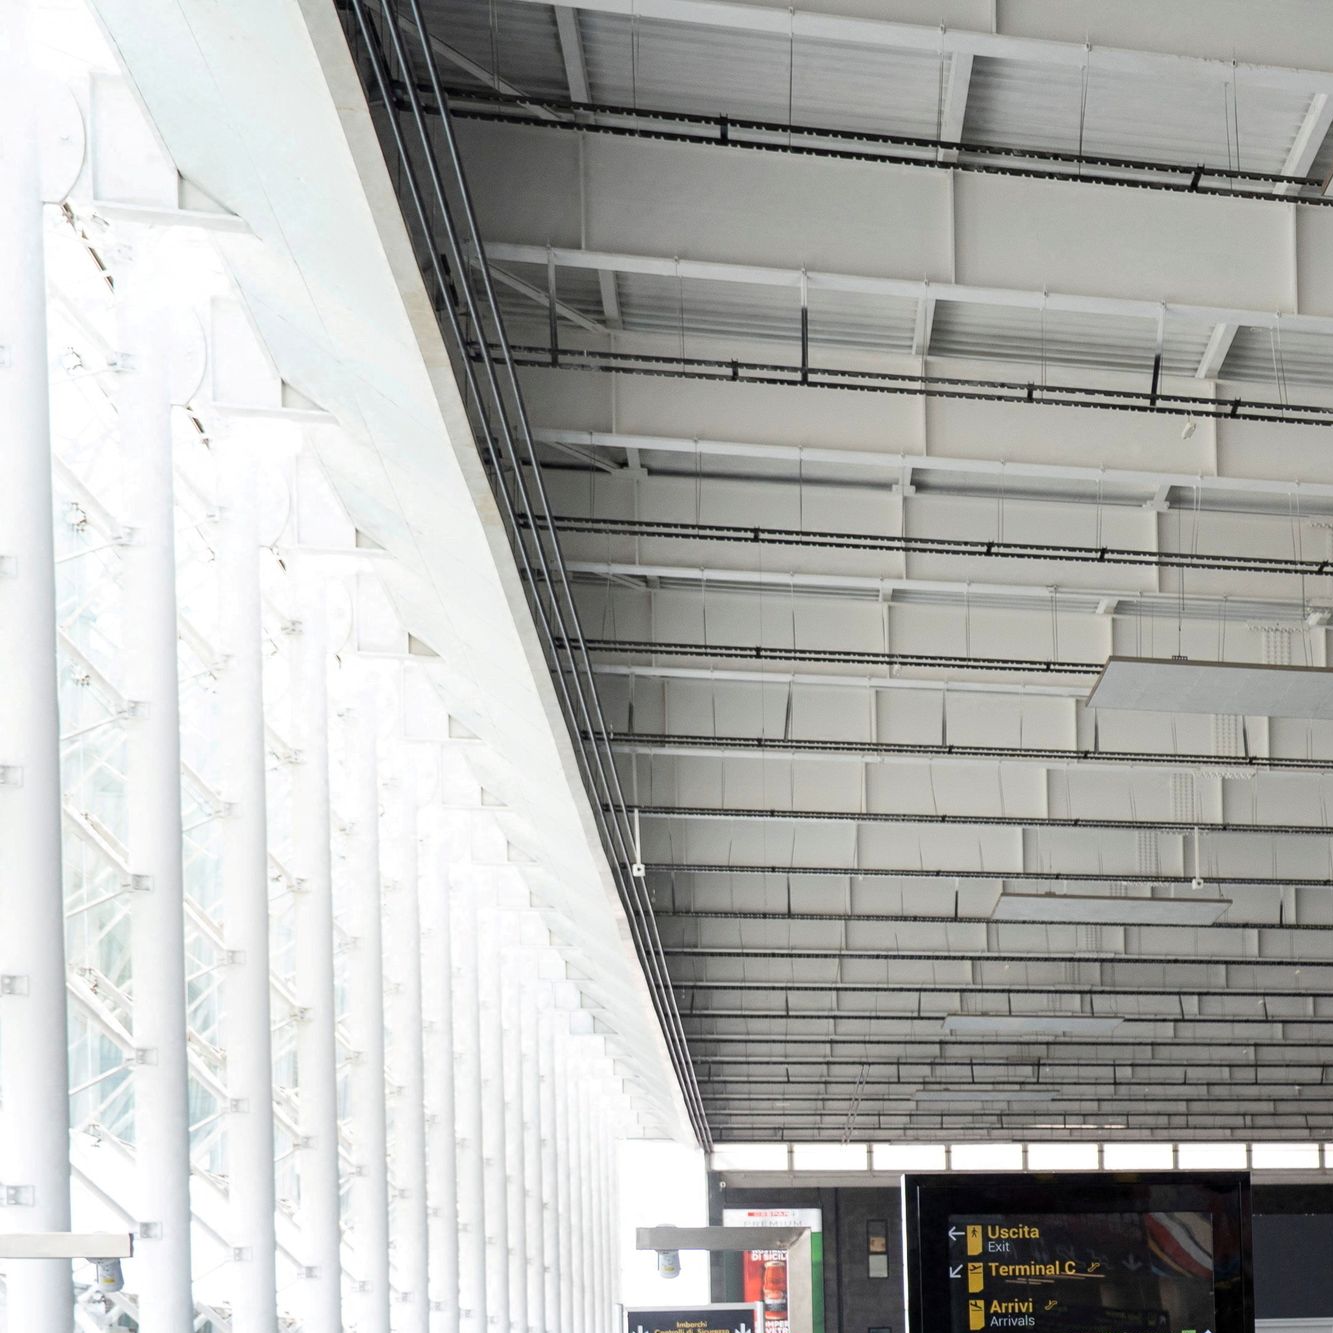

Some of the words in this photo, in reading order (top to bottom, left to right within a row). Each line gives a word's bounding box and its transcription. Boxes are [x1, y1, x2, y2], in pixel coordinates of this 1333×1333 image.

[988, 1225, 1040, 1239] Uscita
[988, 1241, 1009, 1252] Exit
[989, 1262, 1060, 1276] Terminal
[1065, 1261, 1076, 1275] C
[990, 1300, 1033, 1314] Arrivi
[990, 1315, 1035, 1327] Arrivals
